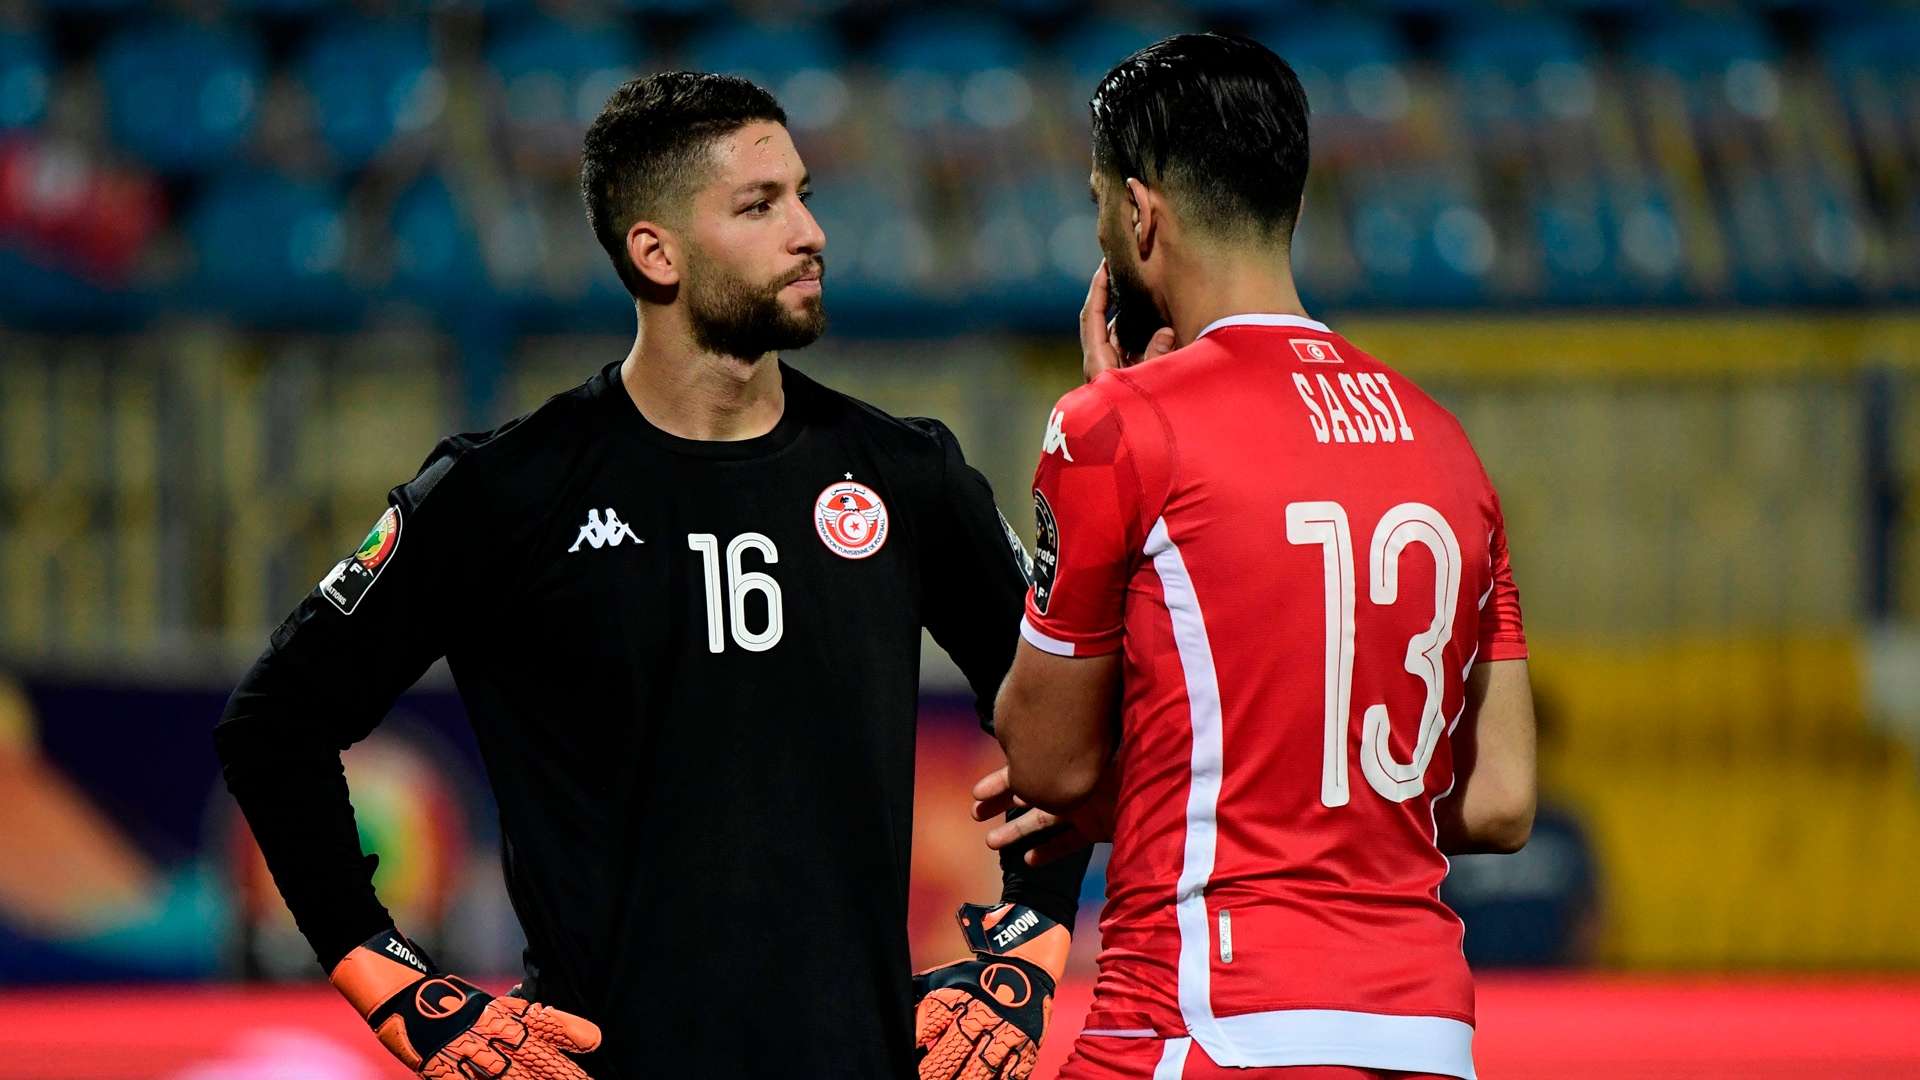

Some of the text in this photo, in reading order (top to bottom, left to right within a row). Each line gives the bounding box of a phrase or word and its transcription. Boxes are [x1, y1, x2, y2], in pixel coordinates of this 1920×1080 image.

[1291, 372, 1415, 444] SASSI
[687, 532, 784, 652] 16
[1285, 500, 1462, 808] 13
[385, 937, 428, 973] MOUEZ
[993, 910, 1040, 947] MOUEZ
